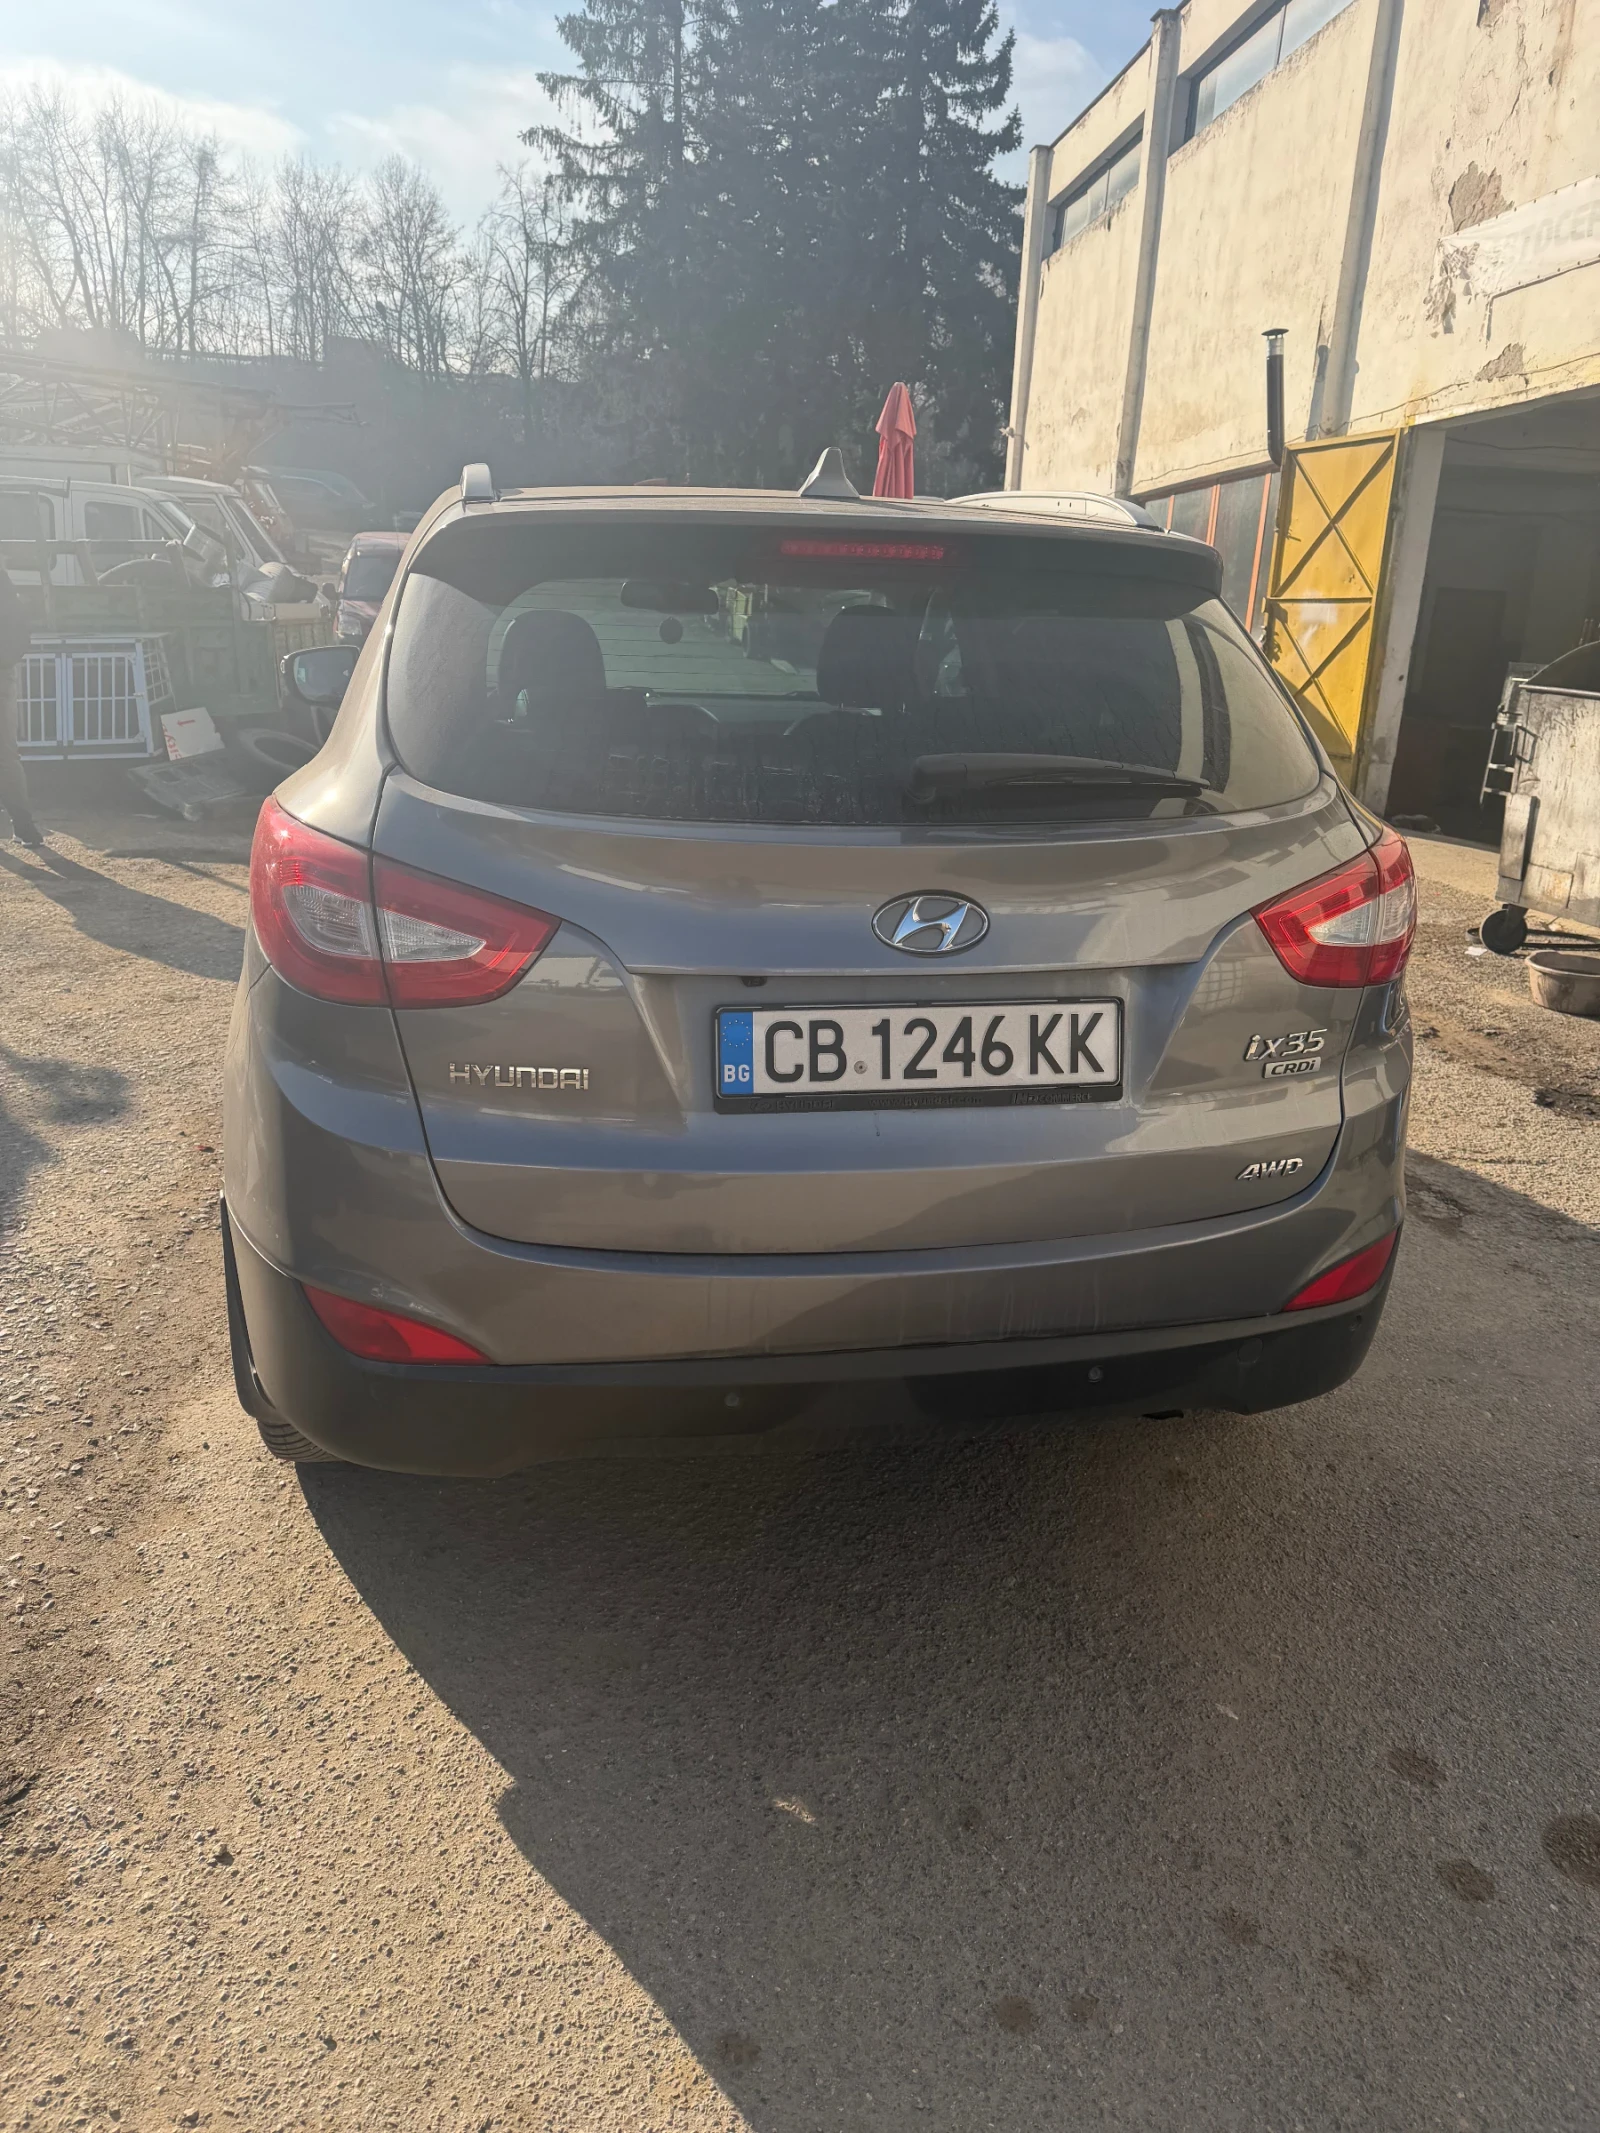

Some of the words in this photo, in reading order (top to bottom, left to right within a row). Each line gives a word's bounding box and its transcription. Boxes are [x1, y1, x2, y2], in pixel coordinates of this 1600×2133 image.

[764, 1019, 848, 1084] CB
[871, 1014, 1014, 1081] 1246
[1028, 1012, 1105, 1077] KK
[1245, 1028, 1328, 1061] ix35
[449, 1063, 589, 1091] HYUNDAI
[724, 1064, 751, 1083] BG
[1270, 1060, 1316, 1076] CRDi
[1236, 1157, 1303, 1181] AWD
